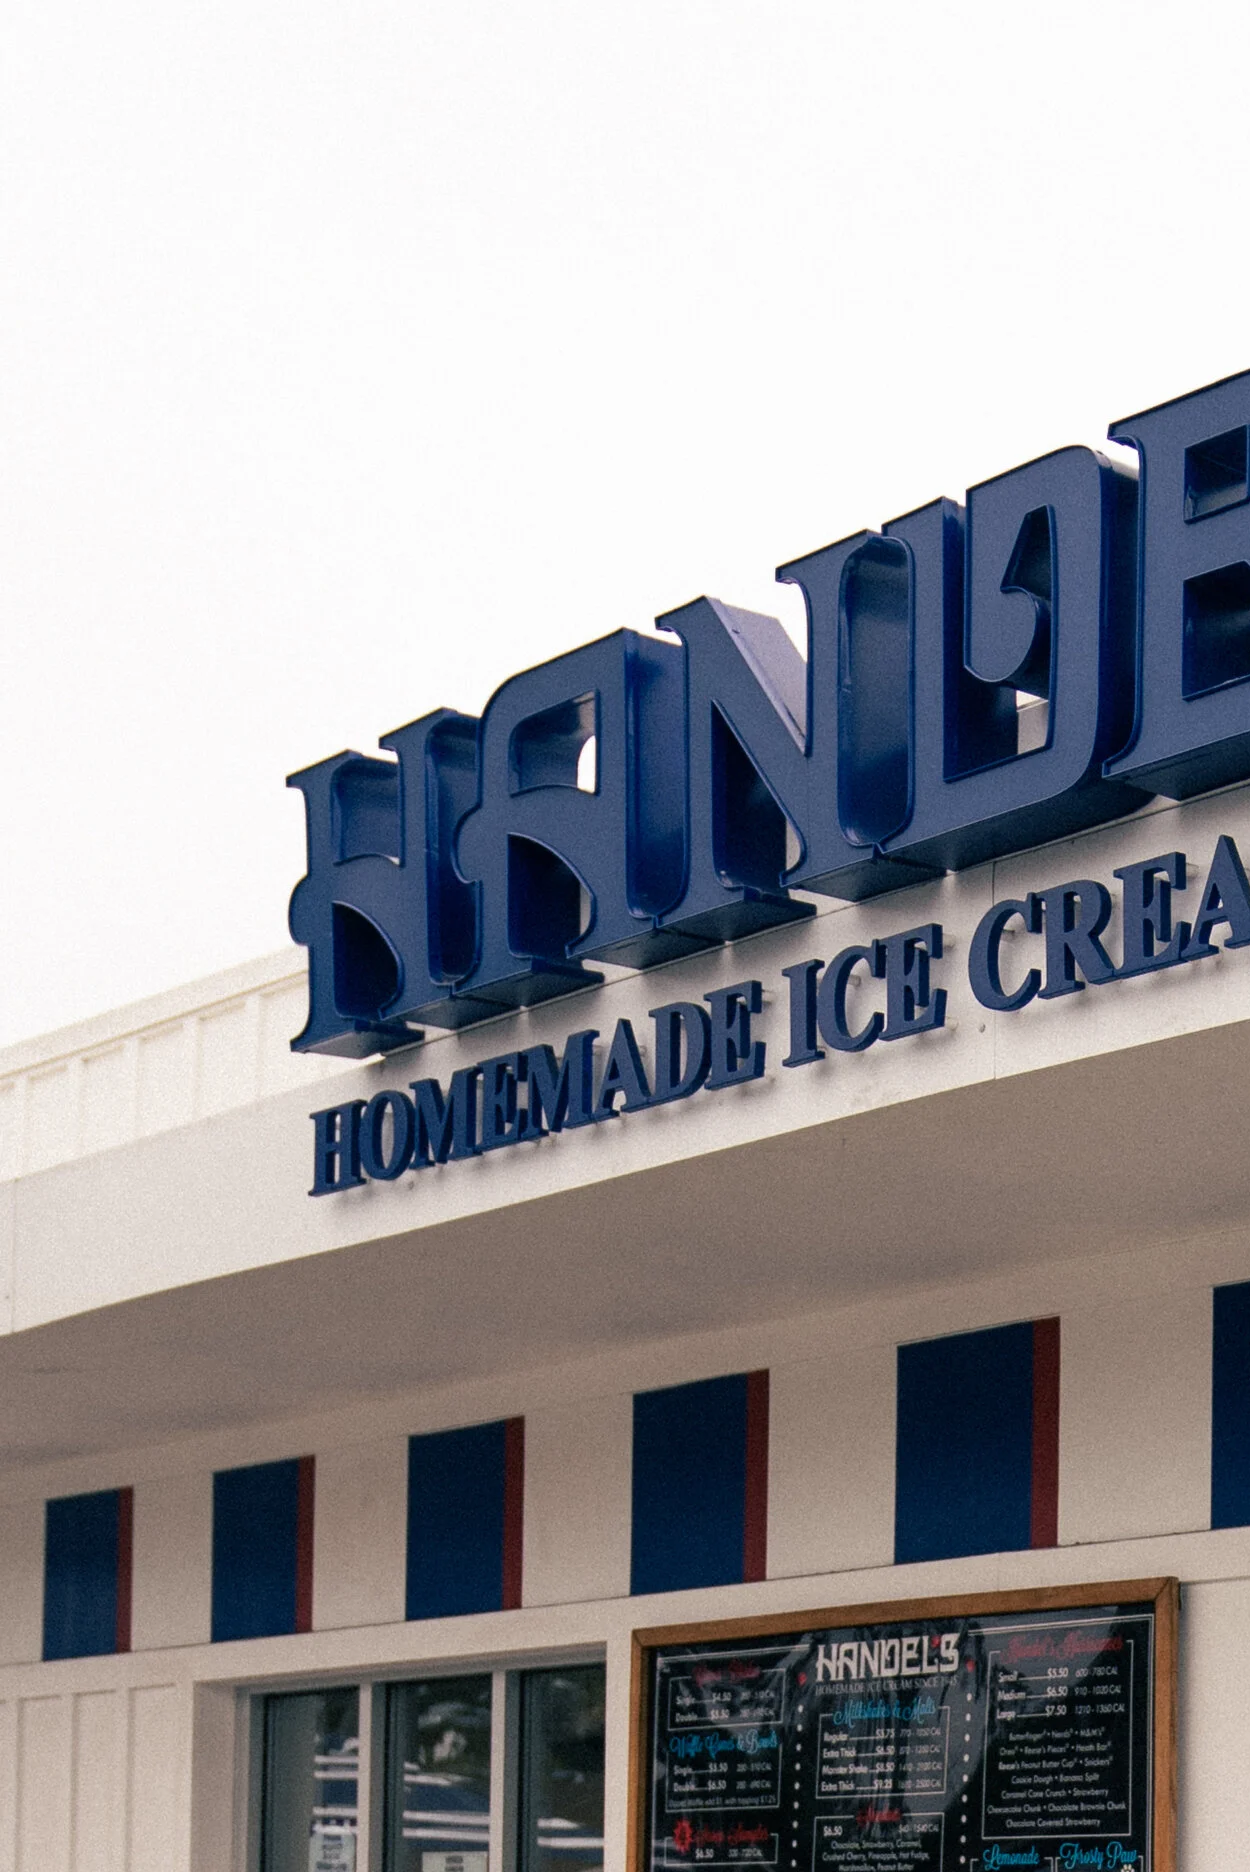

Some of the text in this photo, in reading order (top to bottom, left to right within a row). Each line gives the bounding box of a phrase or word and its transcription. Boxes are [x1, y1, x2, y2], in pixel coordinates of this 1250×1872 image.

[308, 980, 766, 1197] HOMEMADE
[783, 923, 949, 1068] ICE
[815, 1633, 960, 1682] HANDEL'S
[983, 1843, 1040, 1871] Lemonade
[1059, 1841, 1138, 1870] Frosty Paw
